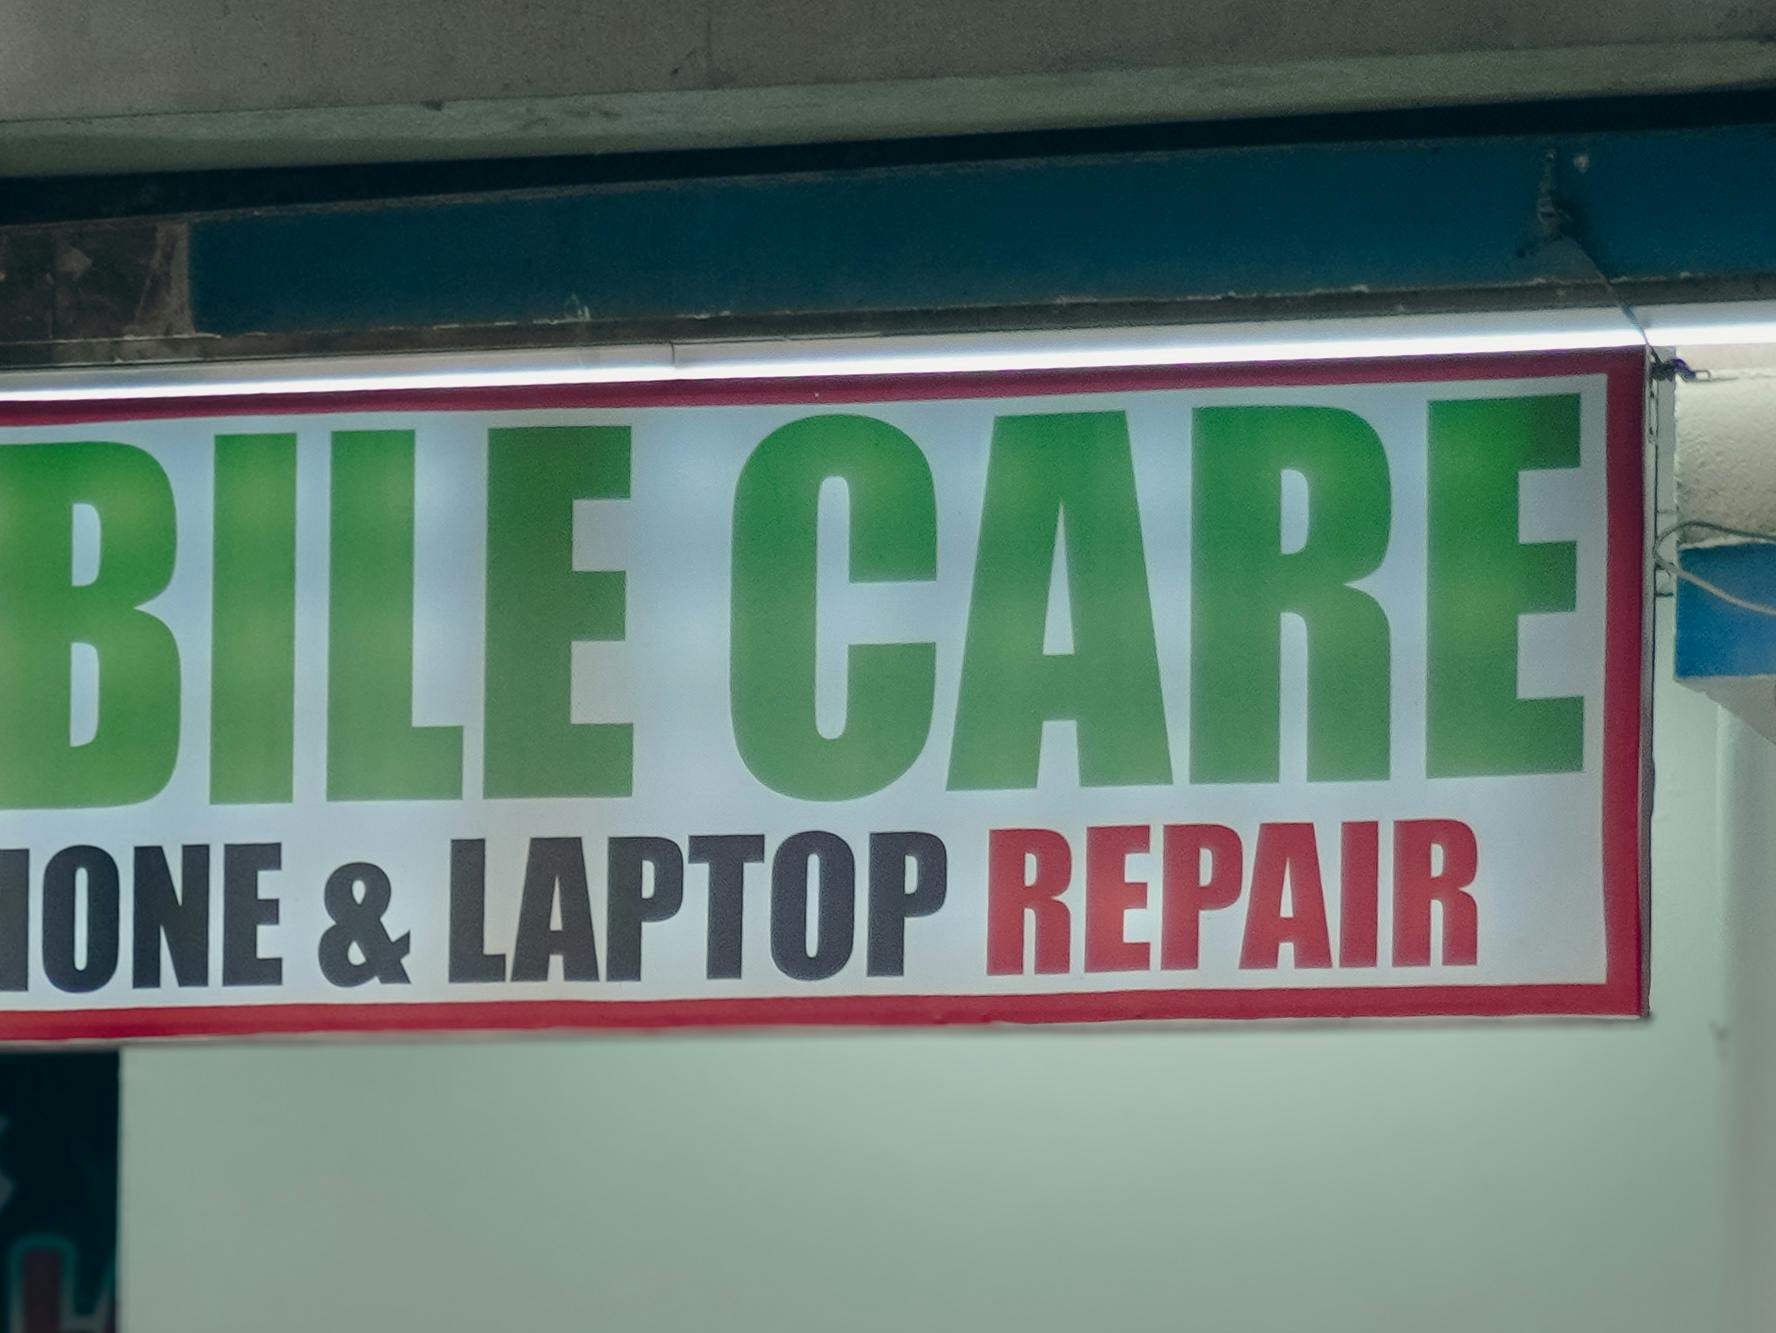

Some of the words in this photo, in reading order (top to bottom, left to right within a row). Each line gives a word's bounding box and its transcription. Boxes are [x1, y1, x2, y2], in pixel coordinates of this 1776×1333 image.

[729, 391, 1586, 803] CARE
[316, 860, 414, 987] &
[448, 830, 948, 986] LAPTOP
[985, 818, 1480, 978] REPAIR
